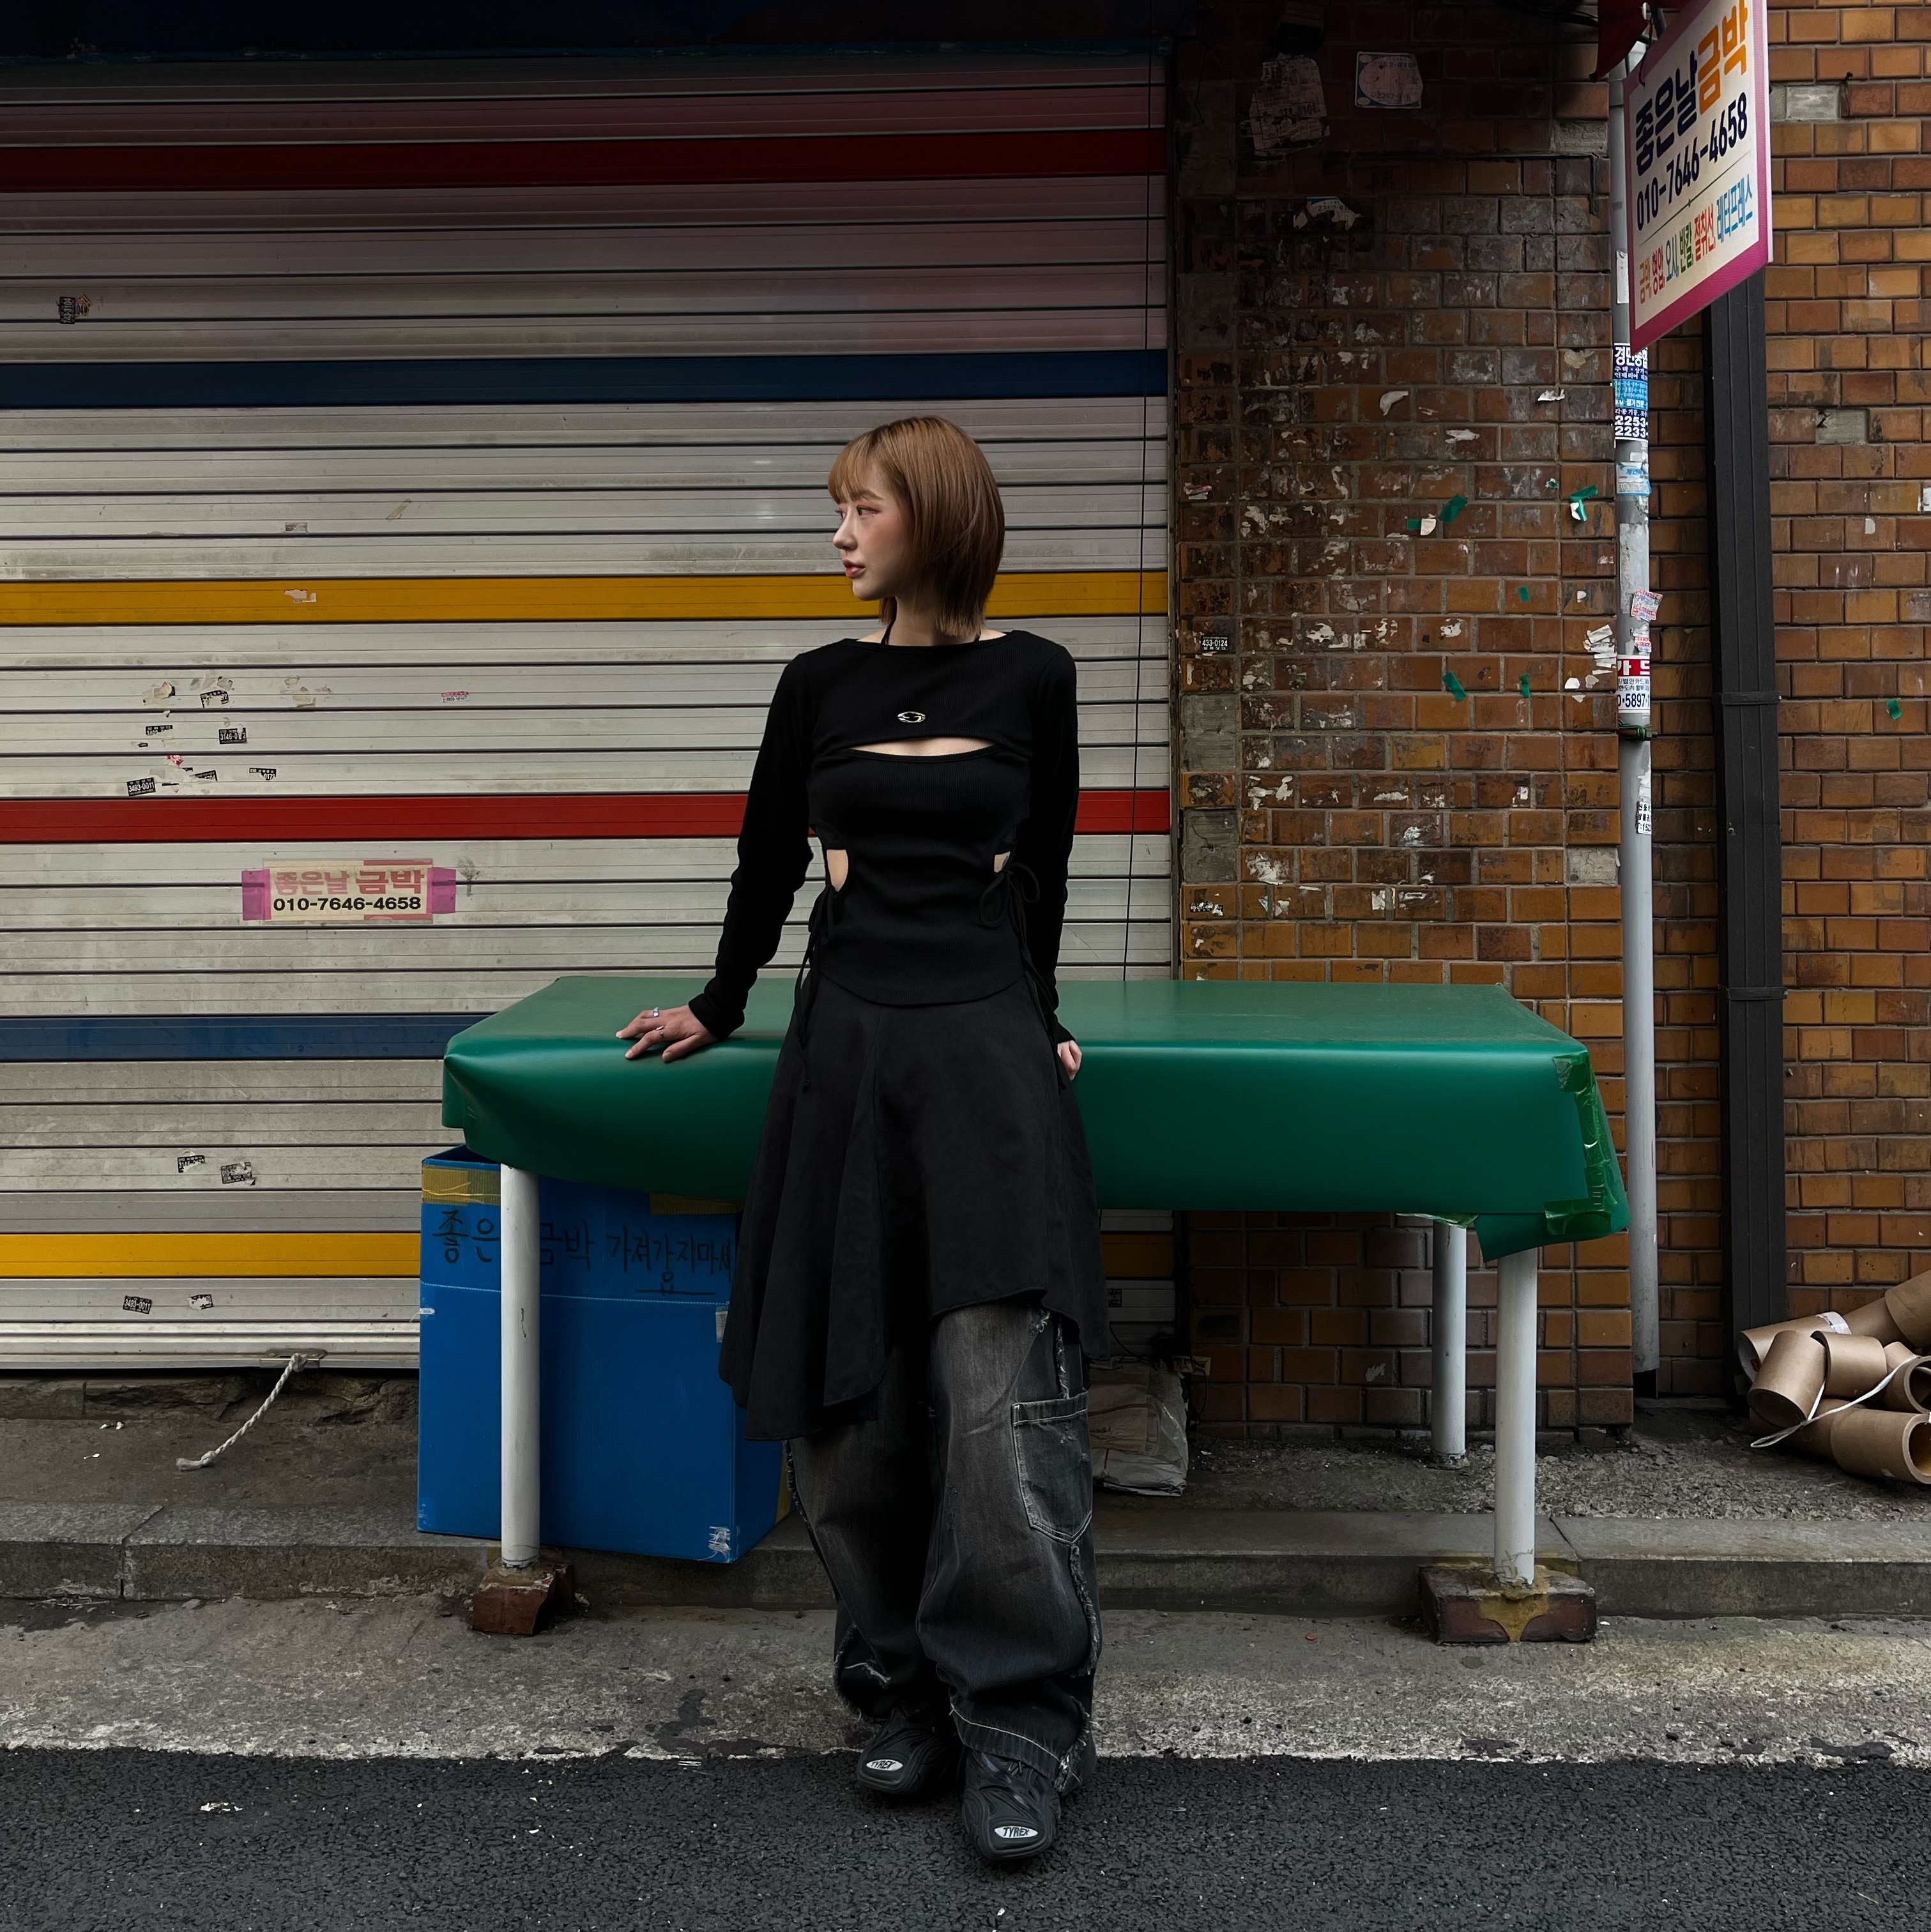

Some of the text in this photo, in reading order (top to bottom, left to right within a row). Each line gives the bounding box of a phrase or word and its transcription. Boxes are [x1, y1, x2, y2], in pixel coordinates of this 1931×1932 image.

[1637, 92, 1748, 231] 010-7646-4658
[1666, 234, 1679, 282] 오시,
[1679, 222, 1693, 273] 반칼,
[1694, 204, 1716, 262] 절취선,
[1716, 174, 1753, 243] 레터프레스
[1202, 639, 1228, 647] 433-0124
[275, 869, 425, 895] 좋은날 금박
[273, 896, 422, 911] 010-7646-4658
[871, 1760, 896, 1770] TYREX
[1003, 1826, 1029, 1838] TYREX
